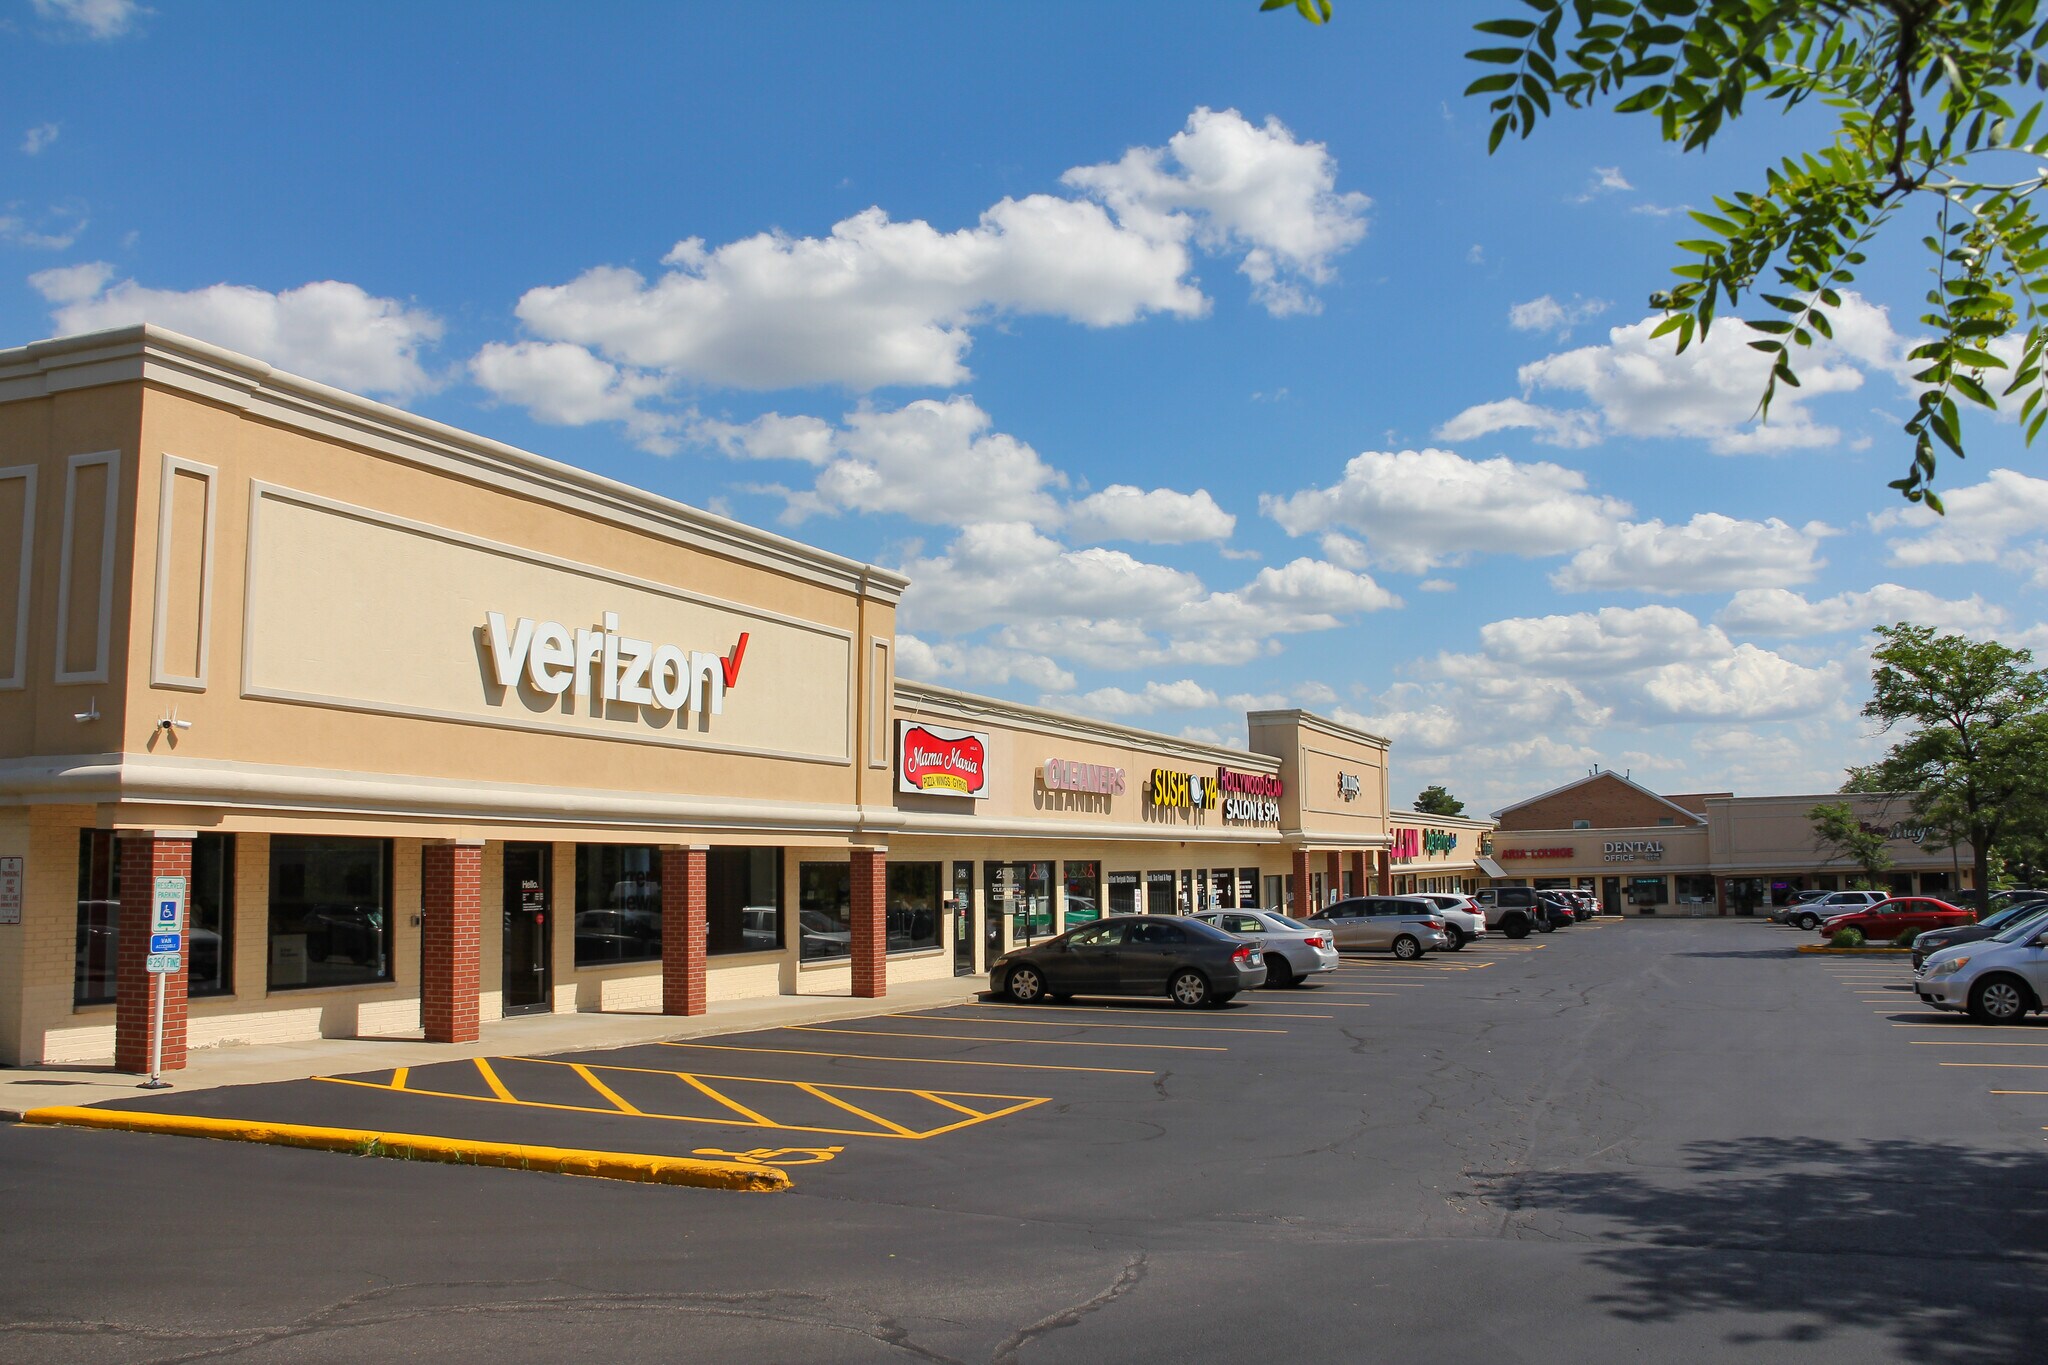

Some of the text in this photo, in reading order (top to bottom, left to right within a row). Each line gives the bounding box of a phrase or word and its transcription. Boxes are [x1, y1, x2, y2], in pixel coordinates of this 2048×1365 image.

[485, 611, 724, 715] verizon
[908, 746, 978, 774] Mama Maria
[923, 776, 967, 792] PIZZA WINGS GYROS
[1045, 758, 1126, 797] CLEANERS
[1220, 767, 1265, 795] HOLLYWOOD
[1226, 799, 1280, 821] SALON & SPA
[1603, 840, 1664, 853] DENTAL
[1604, 854, 1634, 862] OFFICE
[522, 880, 539, 889] Hello.
[148, 957, 180, 968] $250 FINE
